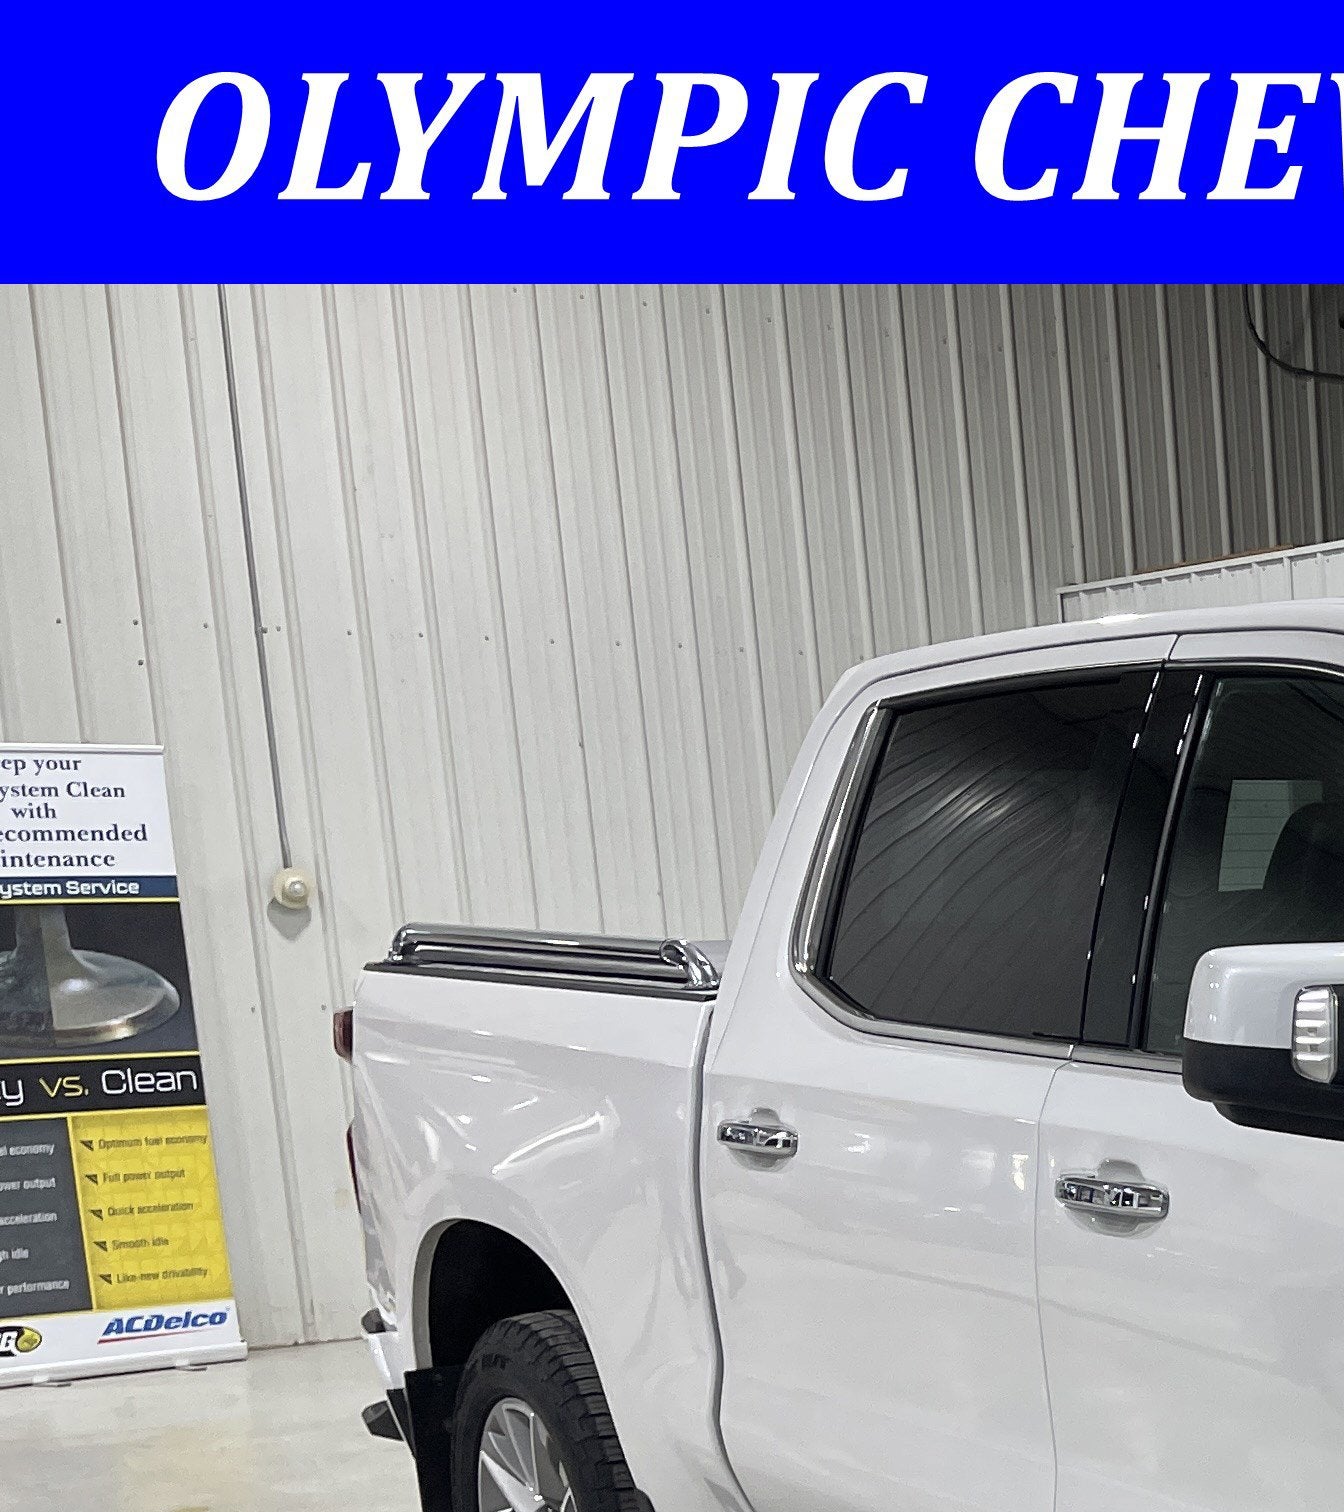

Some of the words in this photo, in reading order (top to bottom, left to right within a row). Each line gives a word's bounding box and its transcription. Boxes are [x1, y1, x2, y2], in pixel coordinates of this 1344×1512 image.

[33, 758, 82, 775] your
[66, 781, 125, 798] Clean
[11, 803, 57, 819] with
[65, 880, 140, 896] Service
[101, 1068, 197, 1095] Clean
[101, 1309, 228, 1337] ACDelco
